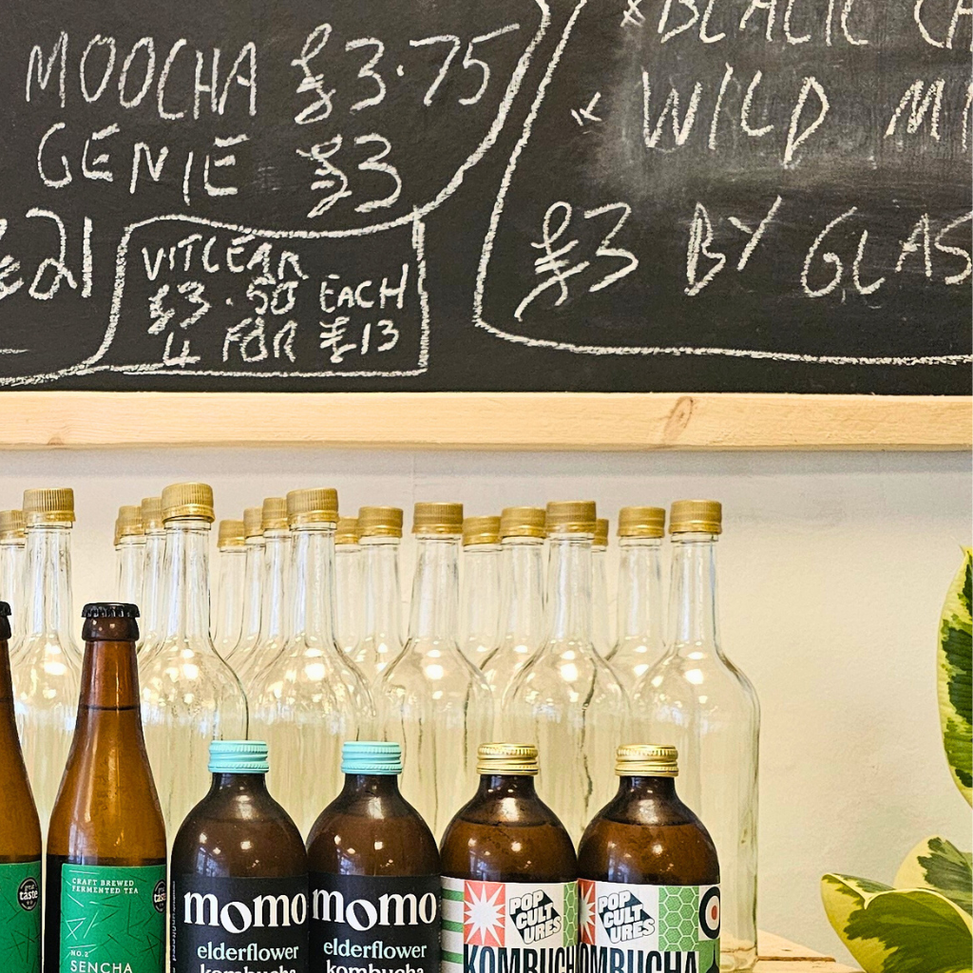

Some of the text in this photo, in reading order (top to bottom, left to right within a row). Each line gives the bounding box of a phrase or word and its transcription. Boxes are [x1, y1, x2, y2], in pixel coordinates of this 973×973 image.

[26, 23, 520, 125] MOOCHA £3.75
[641, 63, 830, 169] WILD
[38, 122, 402, 218] GENIE £3
[514, 201, 639, 321] £3
[684, 195, 782, 296] BY
[320, 263, 409, 312] EACH
[162, 317, 399, 367] 4 FOR £13
[72, 878, 134, 887] CRAFT BREWED
[72, 885, 120, 894] FERMENTED
[184, 892, 306, 933] momo
[312, 888, 436, 931] momo
[509, 889, 544, 915] POP
[598, 889, 633, 914] POP
[515, 905, 554, 928] CULT
[604, 904, 644, 928] CULT
[524, 917, 561, 944] URES
[610, 918, 655, 944] URES
[197, 941, 299, 962] elderflower
[323, 938, 427, 959] elderflower
[70, 960, 133, 973] SENCHA
